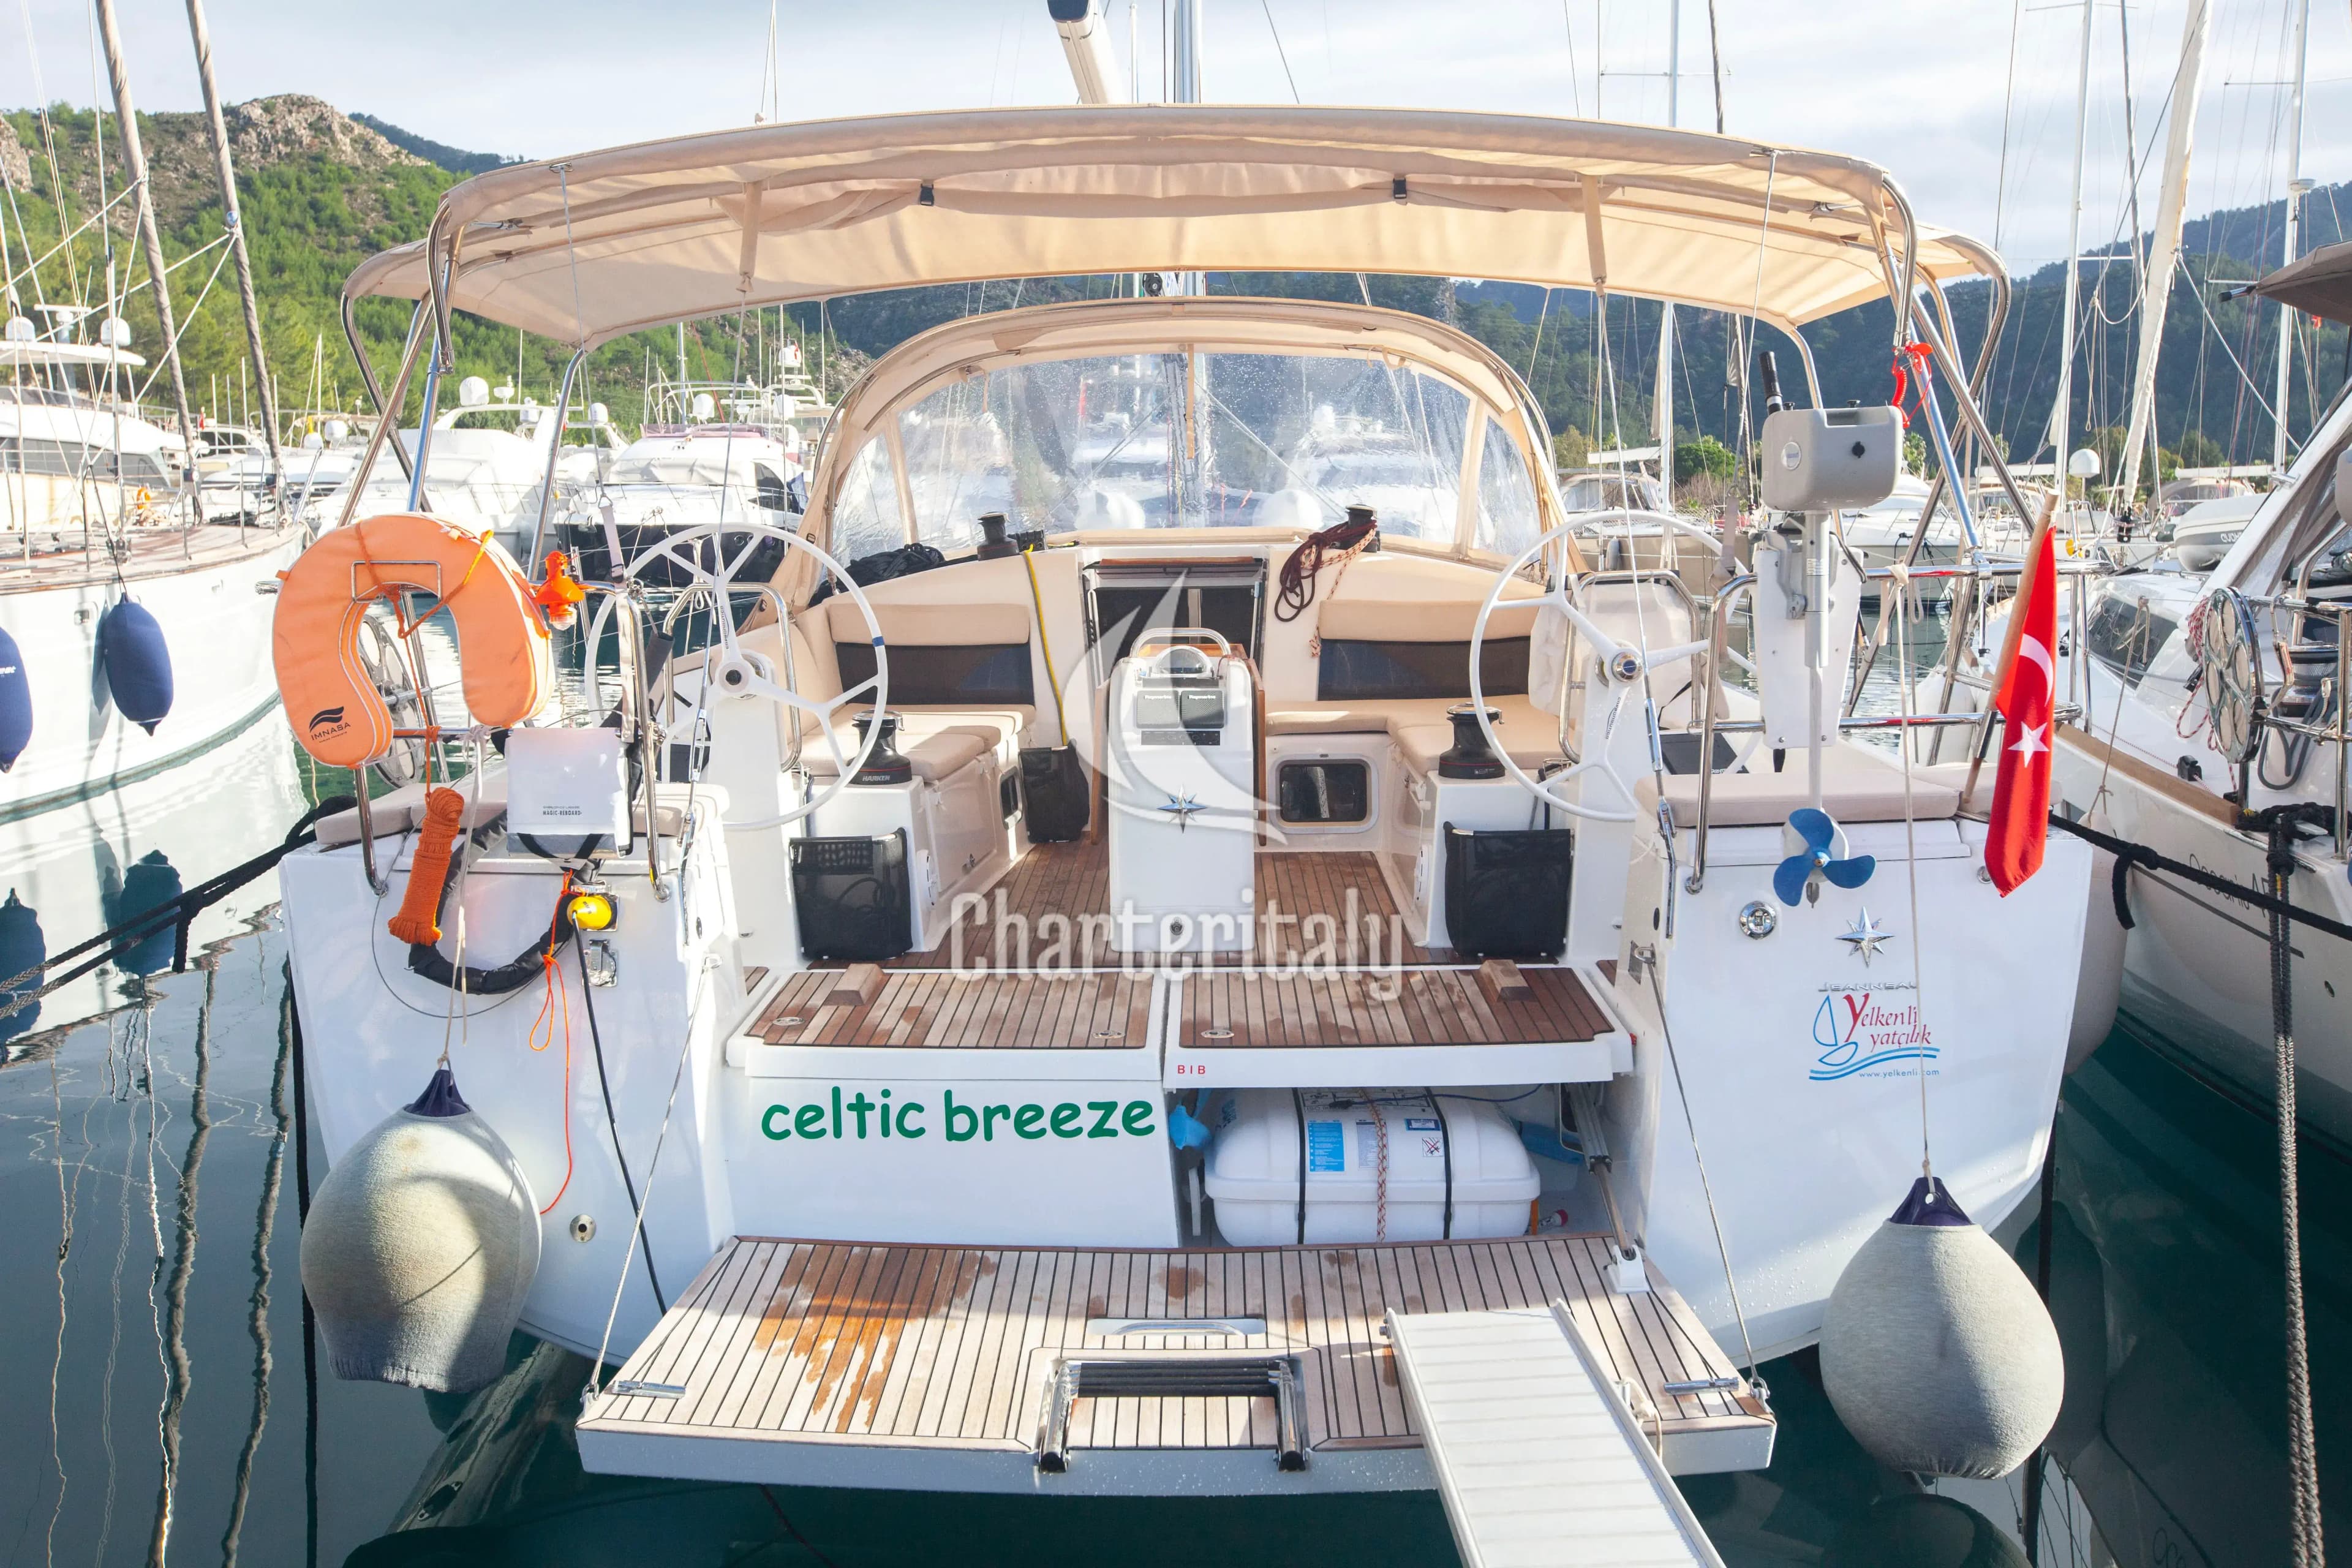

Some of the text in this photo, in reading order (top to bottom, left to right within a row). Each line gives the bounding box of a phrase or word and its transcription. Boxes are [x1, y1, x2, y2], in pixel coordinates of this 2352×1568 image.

[311, 722, 351, 741] IMNASA
[1842, 992, 1918, 1042] Yelkenli
[761, 1085, 1156, 1142] celtic breeze
